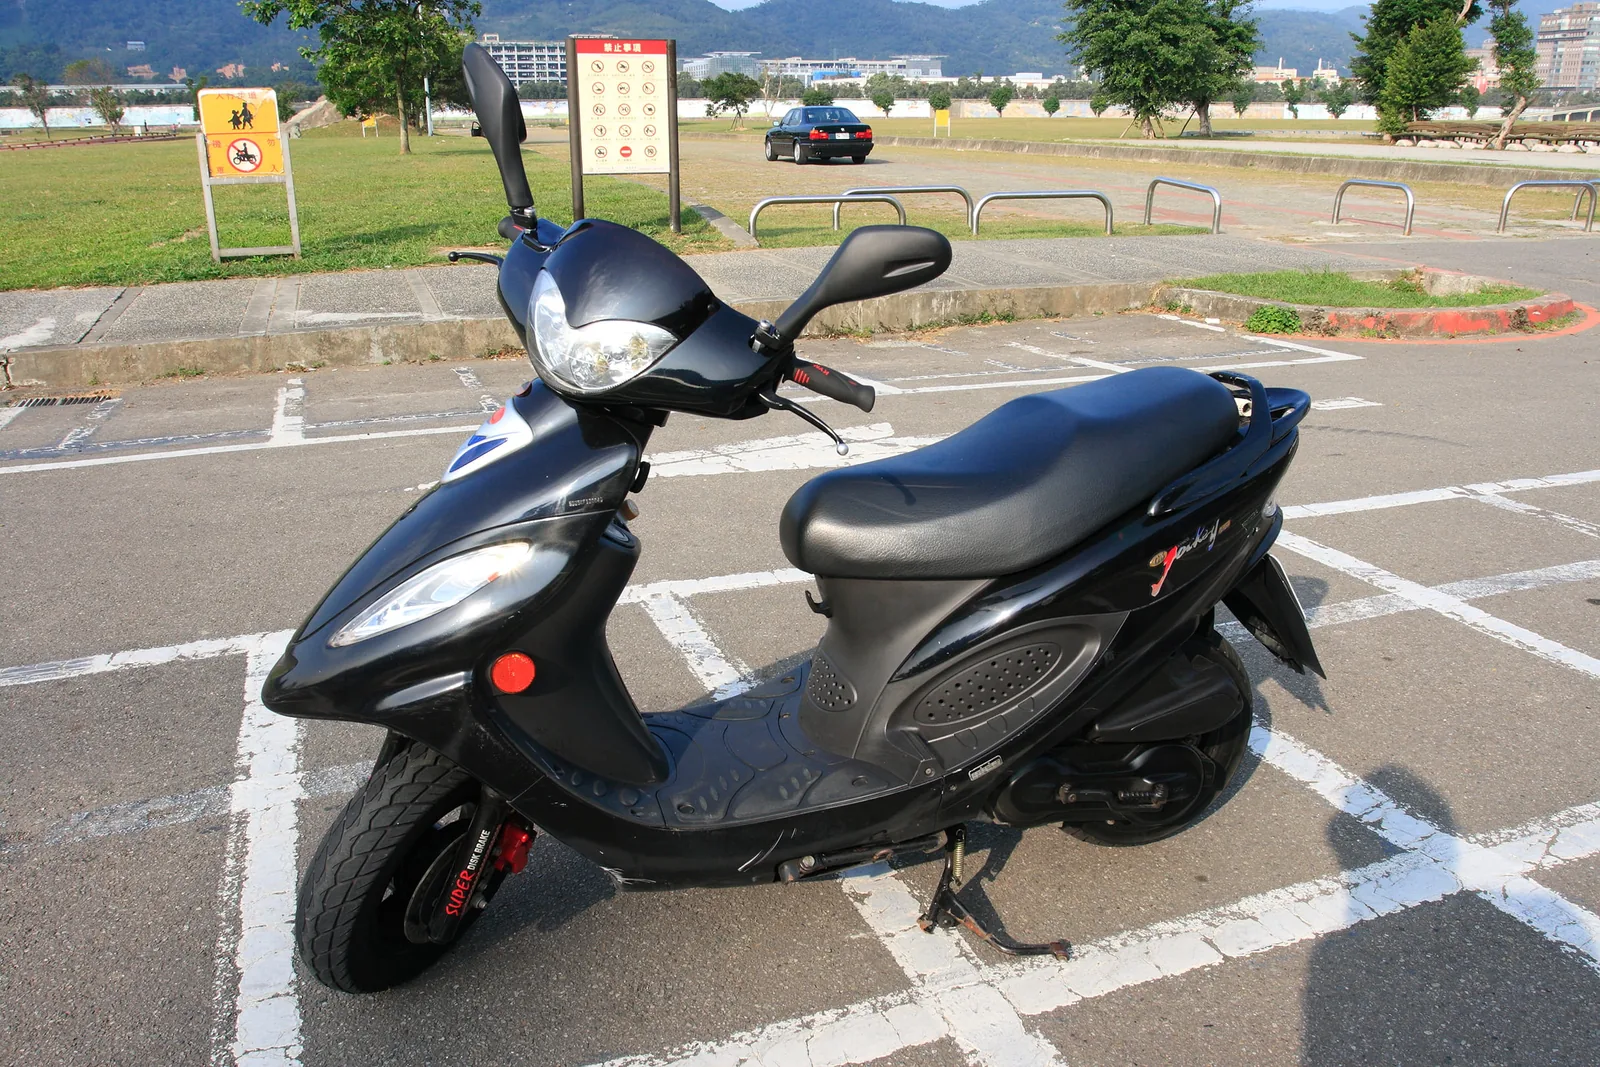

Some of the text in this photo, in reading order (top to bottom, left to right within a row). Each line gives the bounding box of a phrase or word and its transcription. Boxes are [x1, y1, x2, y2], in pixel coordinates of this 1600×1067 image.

[603, 42, 642, 53] 禁止事項
[445, 829, 491, 917] SUPER DISK BRAKE
